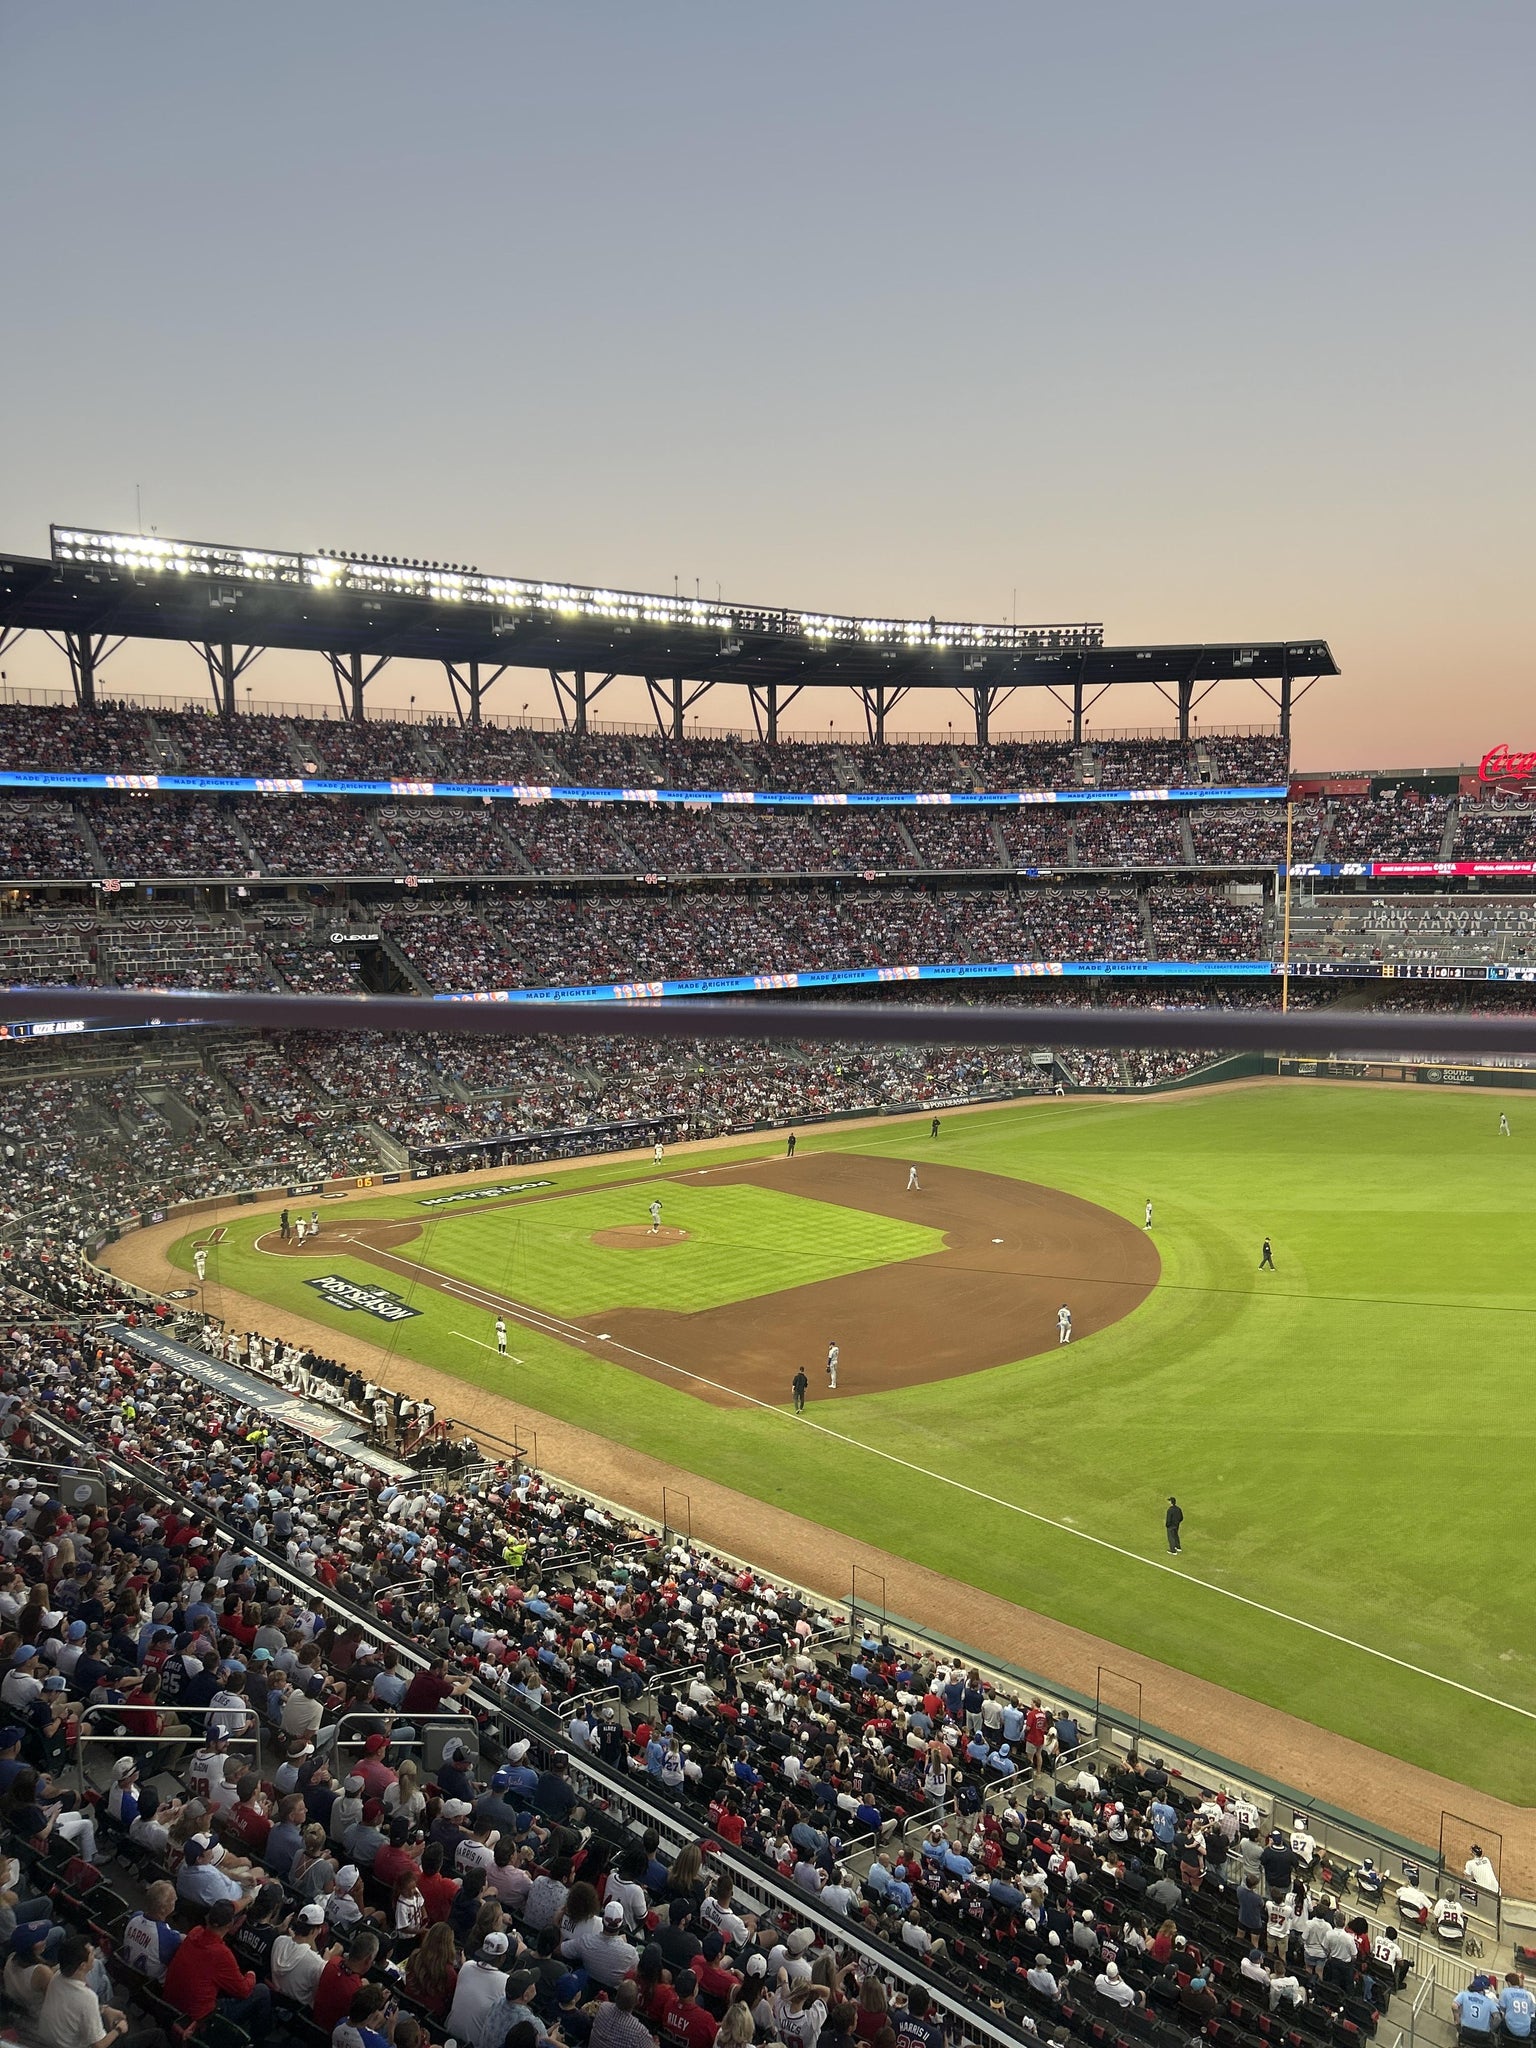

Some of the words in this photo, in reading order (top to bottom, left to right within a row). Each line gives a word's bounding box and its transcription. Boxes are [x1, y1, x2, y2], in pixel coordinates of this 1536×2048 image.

[43, 775, 88, 784] BRIGHTER
[102, 879, 120, 891] 35
[1363, 911, 1413, 929] HANK
[1418, 911, 1483, 930] AARON
[958, 967, 998, 976] BRIGHTER
[1104, 965, 1148, 973] BRIGHTER
[832, 973, 865, 982] BRIGHTER
[702, 981, 739, 991] BRIGHTER
[553, 989, 597, 1000] BRIGHTER
[930, 1098, 969, 1108] POSTSEASON
[311, 1277, 414, 1320] POSTSEASON
[155, 1346, 195, 1364] TRUIST
[197, 1367, 232, 1383] PARK
[164, 1659, 182, 1672] JONES
[161, 1673, 186, 1694] 25
[666, 1762, 678, 1772] 27
[933, 1774, 944, 1785] 10
[1154, 1814, 1166, 1826] 44
[1238, 1811, 1249, 1823] 13
[1293, 1840, 1306, 1851] 27
[705, 1906, 723, 1926] OLSON
[1270, 1913, 1285, 1926] 27
[127, 1927, 152, 1949] AARON
[238, 1929, 260, 1950] ARRIS
[1376, 1945, 1390, 1962] 13
[1471, 2005, 1479, 2018] 3
[1513, 2000, 1528, 2015] 99
[667, 2012, 690, 2032] RILEY
[899, 2016, 925, 2033] HARRIS
[922, 2026, 930, 2036] II
